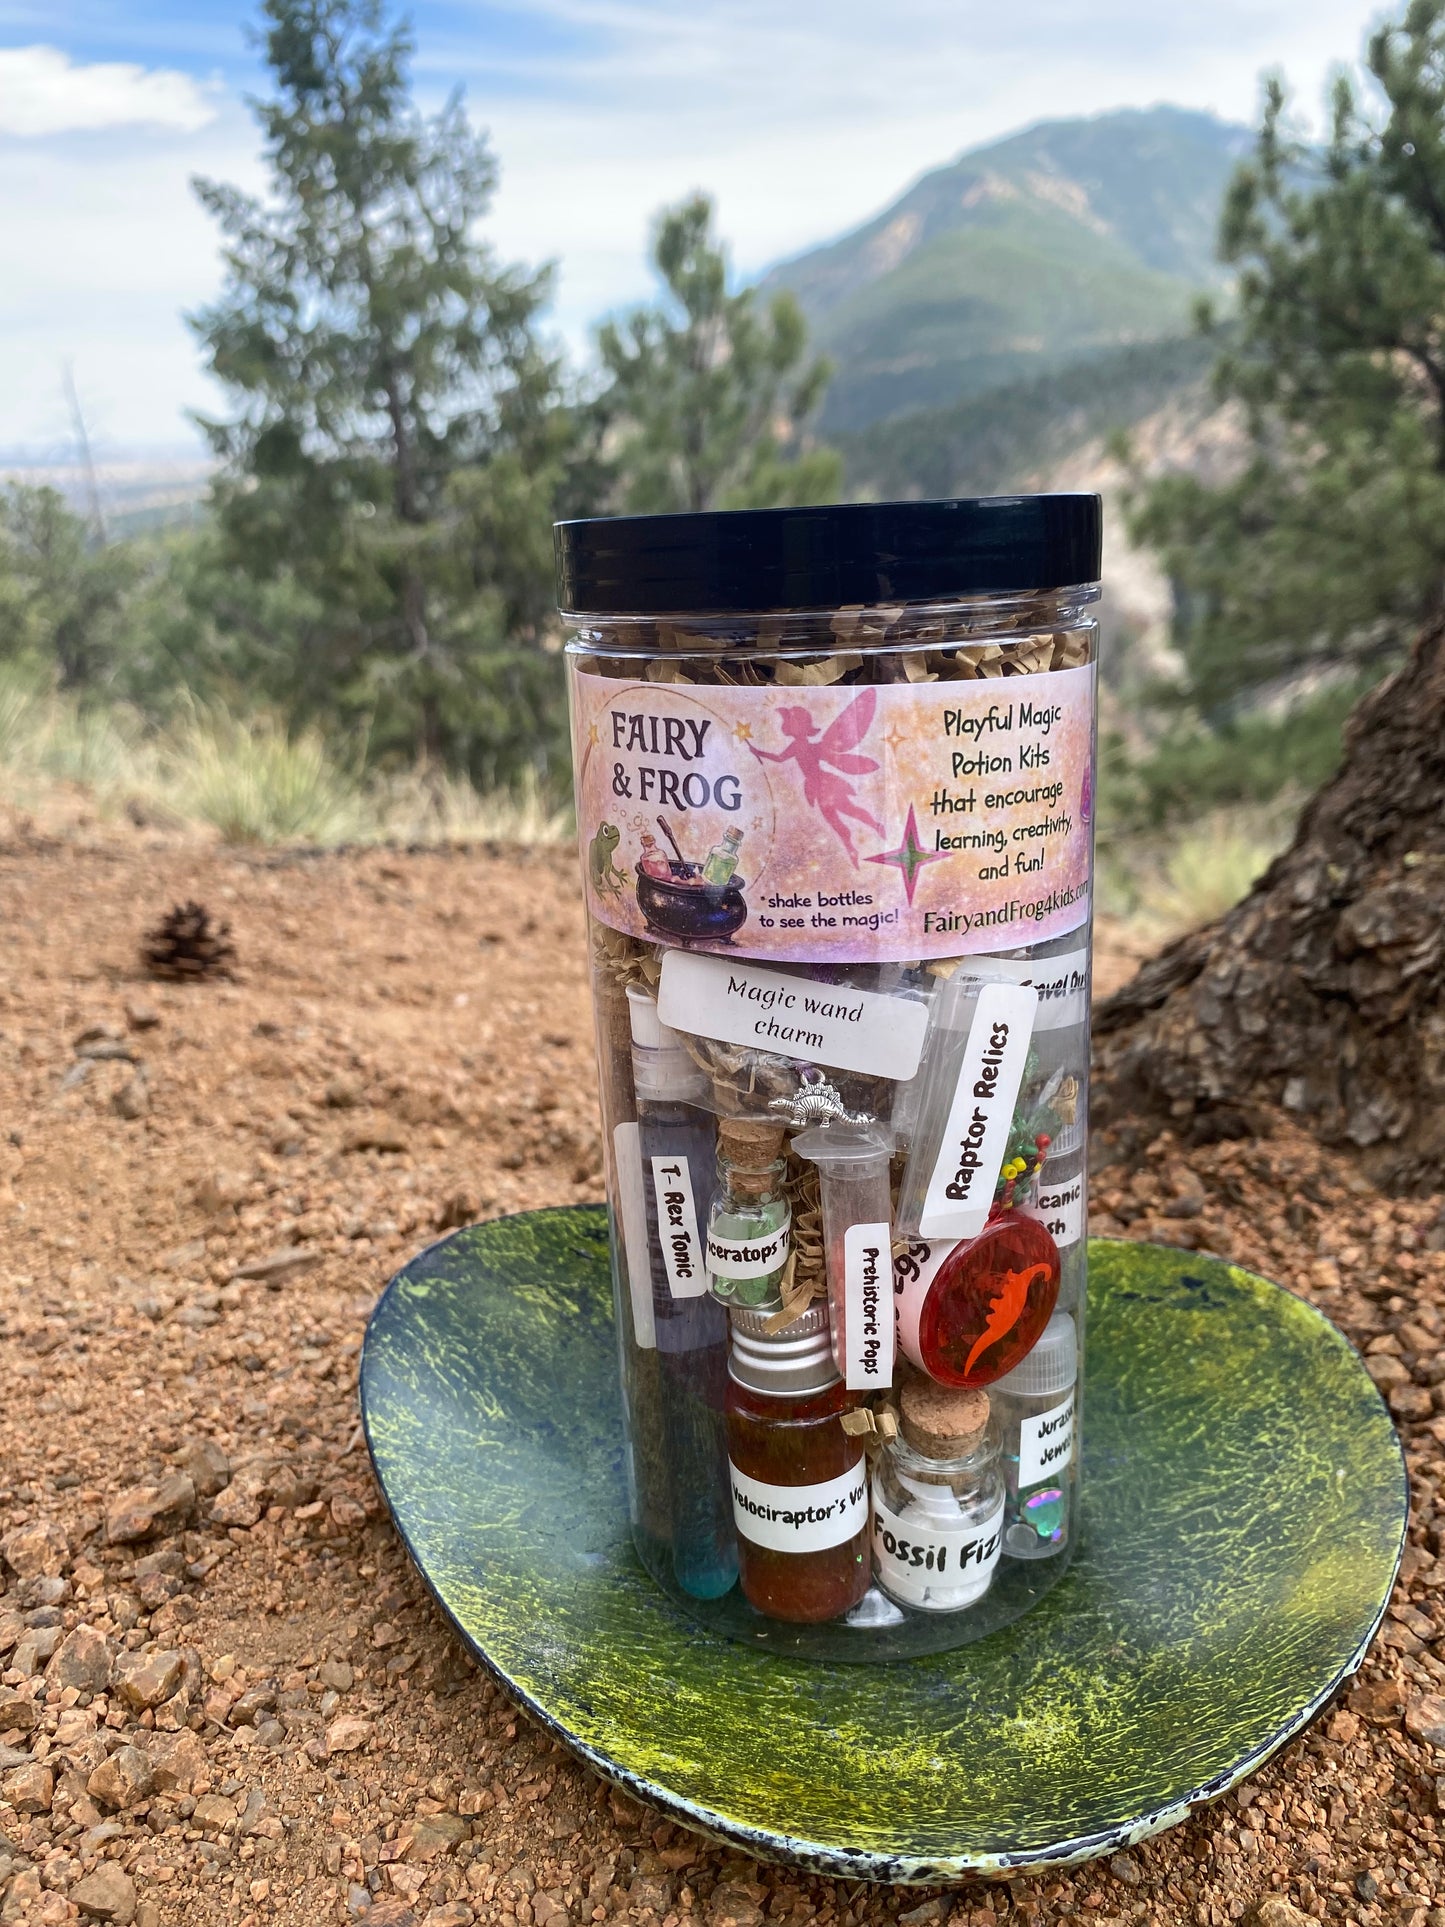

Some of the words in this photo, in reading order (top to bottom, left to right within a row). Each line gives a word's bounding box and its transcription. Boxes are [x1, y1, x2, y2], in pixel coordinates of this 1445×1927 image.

[611, 711, 711, 761] FAIRY
[943, 705, 1013, 742] Playful
[1019, 702, 1061, 735] Magic
[952, 751, 1012, 778] Potion
[1019, 743, 1050, 770] Kits
[612, 762, 632, 799] &
[638, 766, 742, 811] FROG
[930, 788, 977, 816] that
[984, 781, 1063, 808] encourage
[936, 829, 1008, 853] learning,
[1012, 810, 1072, 842] creativity,
[978, 861, 1009, 880] and
[1014, 848, 1045, 873] fun!
[818, 890, 873, 907] bottles
[759, 915, 775, 928] to
[779, 918, 805, 928] see
[811, 912, 837, 928] the
[843, 908, 899, 931] magic!
[727, 976, 796, 1010] Magic
[804, 1002, 864, 1022] wand
[754, 1016, 824, 1049] charm
[945, 1106, 988, 1201] Raptor
[973, 1022, 1009, 1099] Relics
[663, 1191, 685, 1227] Rex
[1038, 1219, 1066, 1235] sh
[670, 1230, 695, 1279] Tonic
[862, 1247, 881, 1336] Prehistoric
[858, 1338, 881, 1375] Pops
[732, 1481, 846, 1530] Velociraptor's
[874, 1511, 947, 1572] Fossil
